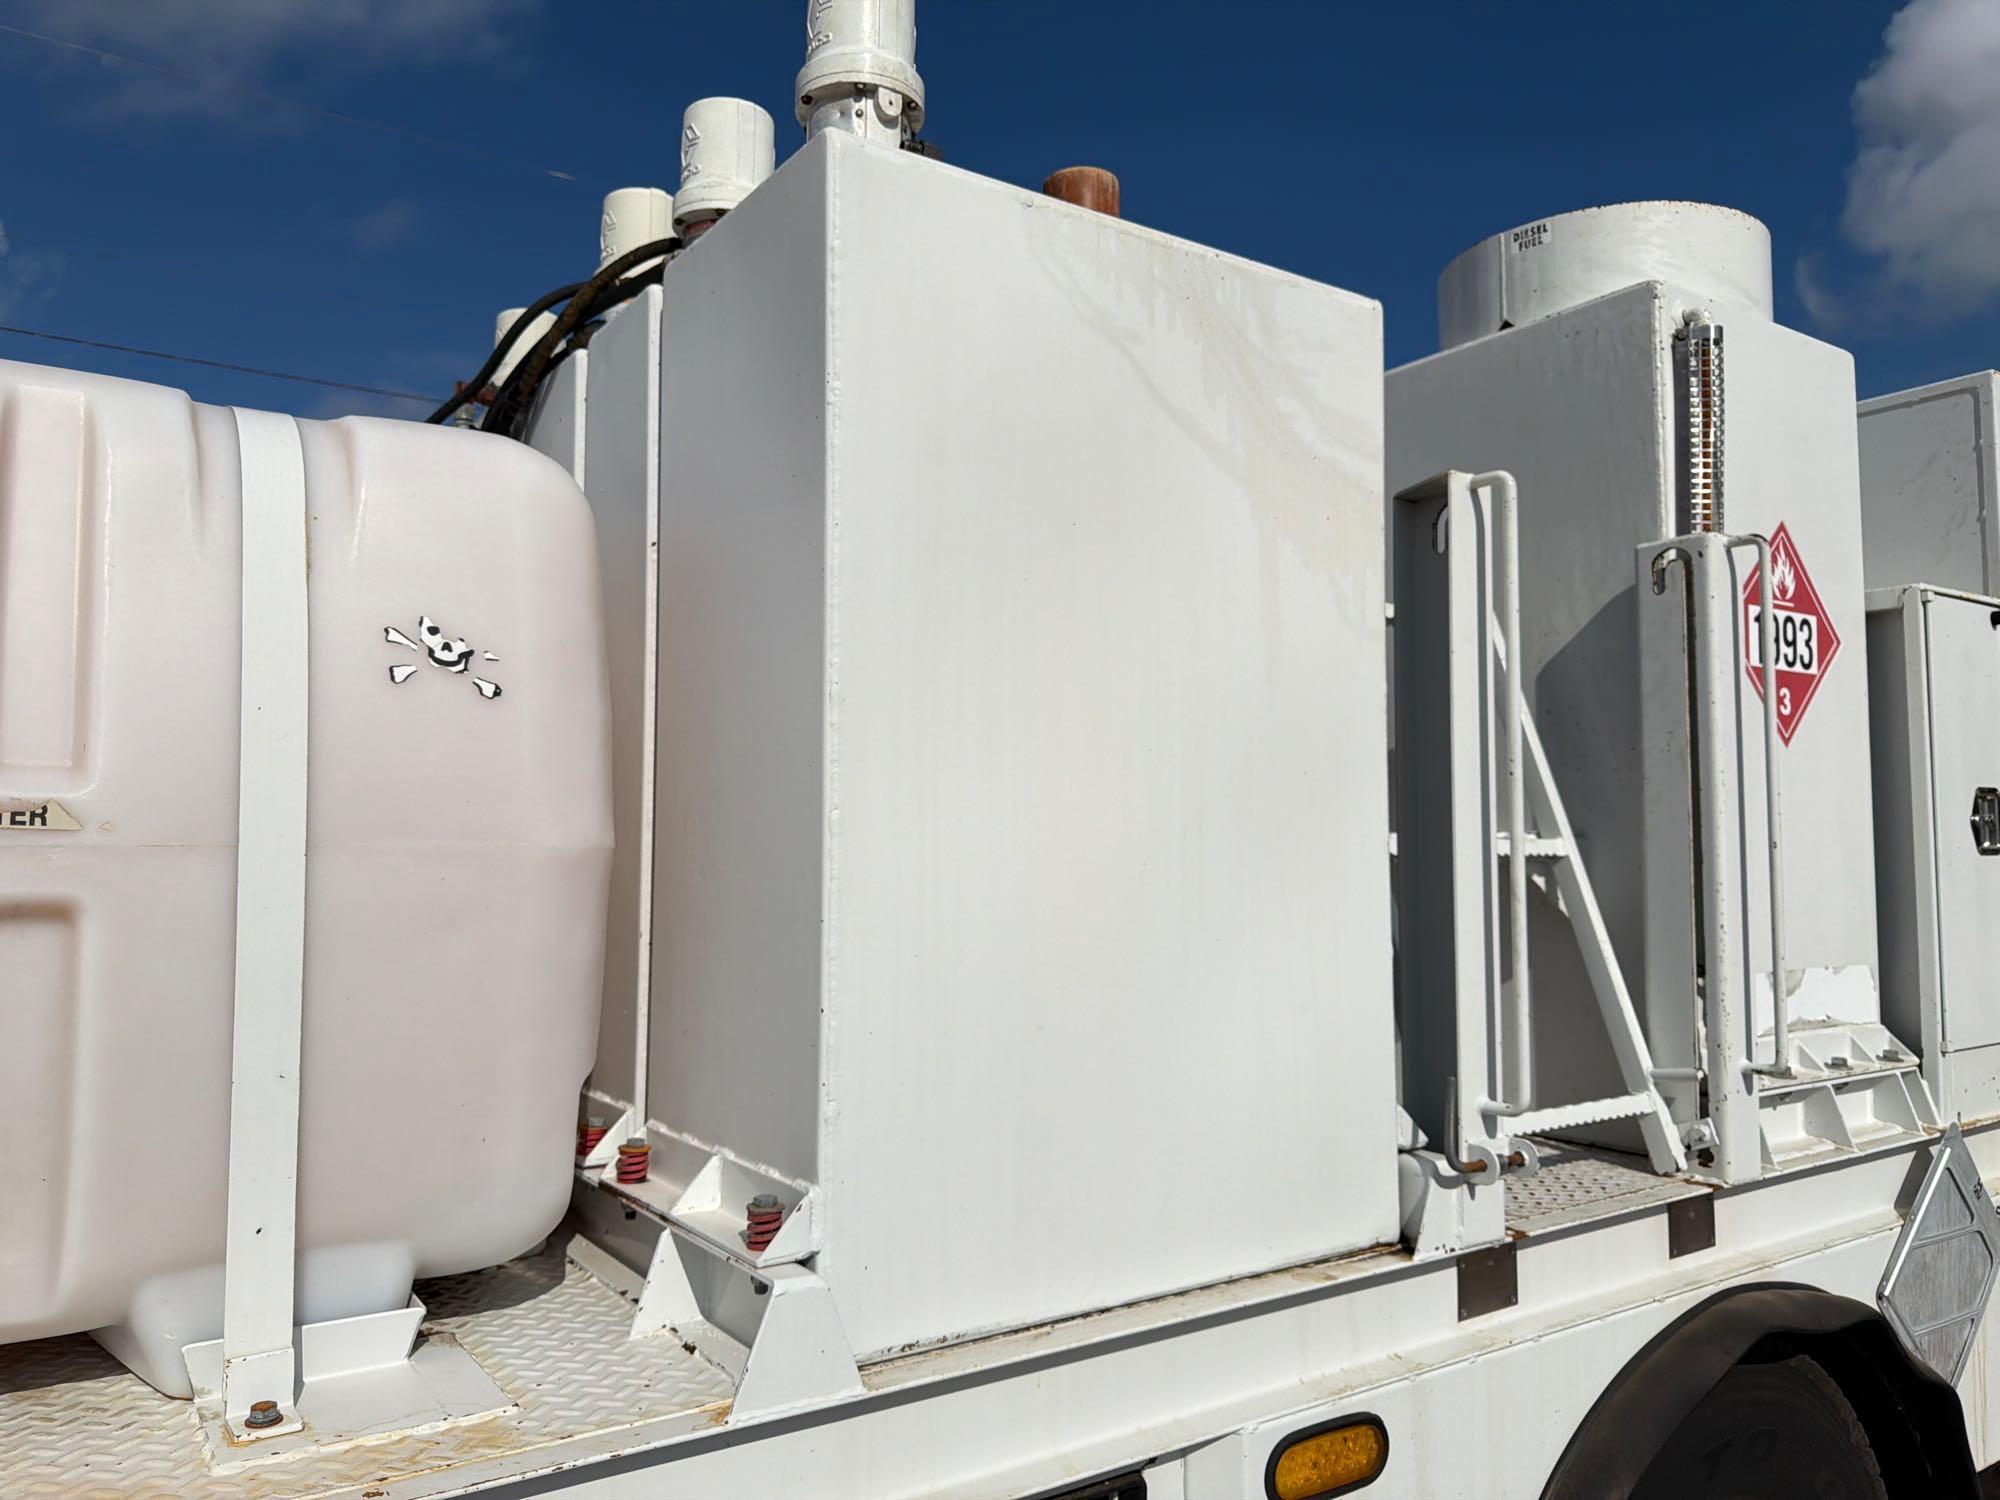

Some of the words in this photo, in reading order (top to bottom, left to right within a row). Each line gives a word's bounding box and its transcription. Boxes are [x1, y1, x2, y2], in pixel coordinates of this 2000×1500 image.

[1513, 223, 1548, 243] DIESEL
[1518, 236, 1543, 252] FUEL
[1779, 687, 1792, 716] 3
